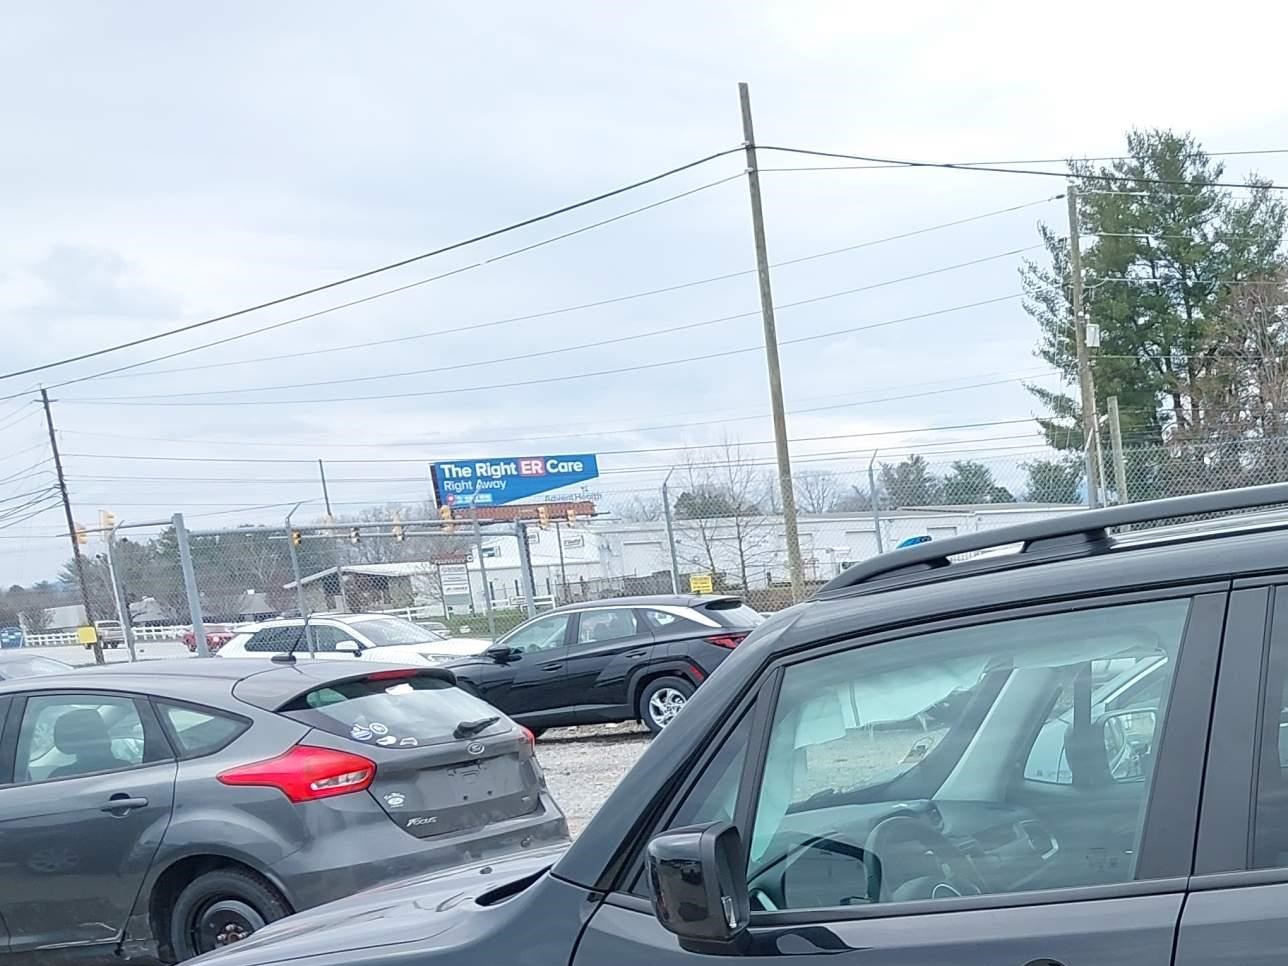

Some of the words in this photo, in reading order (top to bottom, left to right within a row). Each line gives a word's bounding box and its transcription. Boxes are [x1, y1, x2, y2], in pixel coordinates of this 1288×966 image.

[440, 464, 472, 478] The
[475, 462, 518, 479] Right
[521, 460, 544, 474] ER
[546, 459, 583, 473] Care
[443, 480, 473, 493] Right
[476, 479, 507, 491] Away
